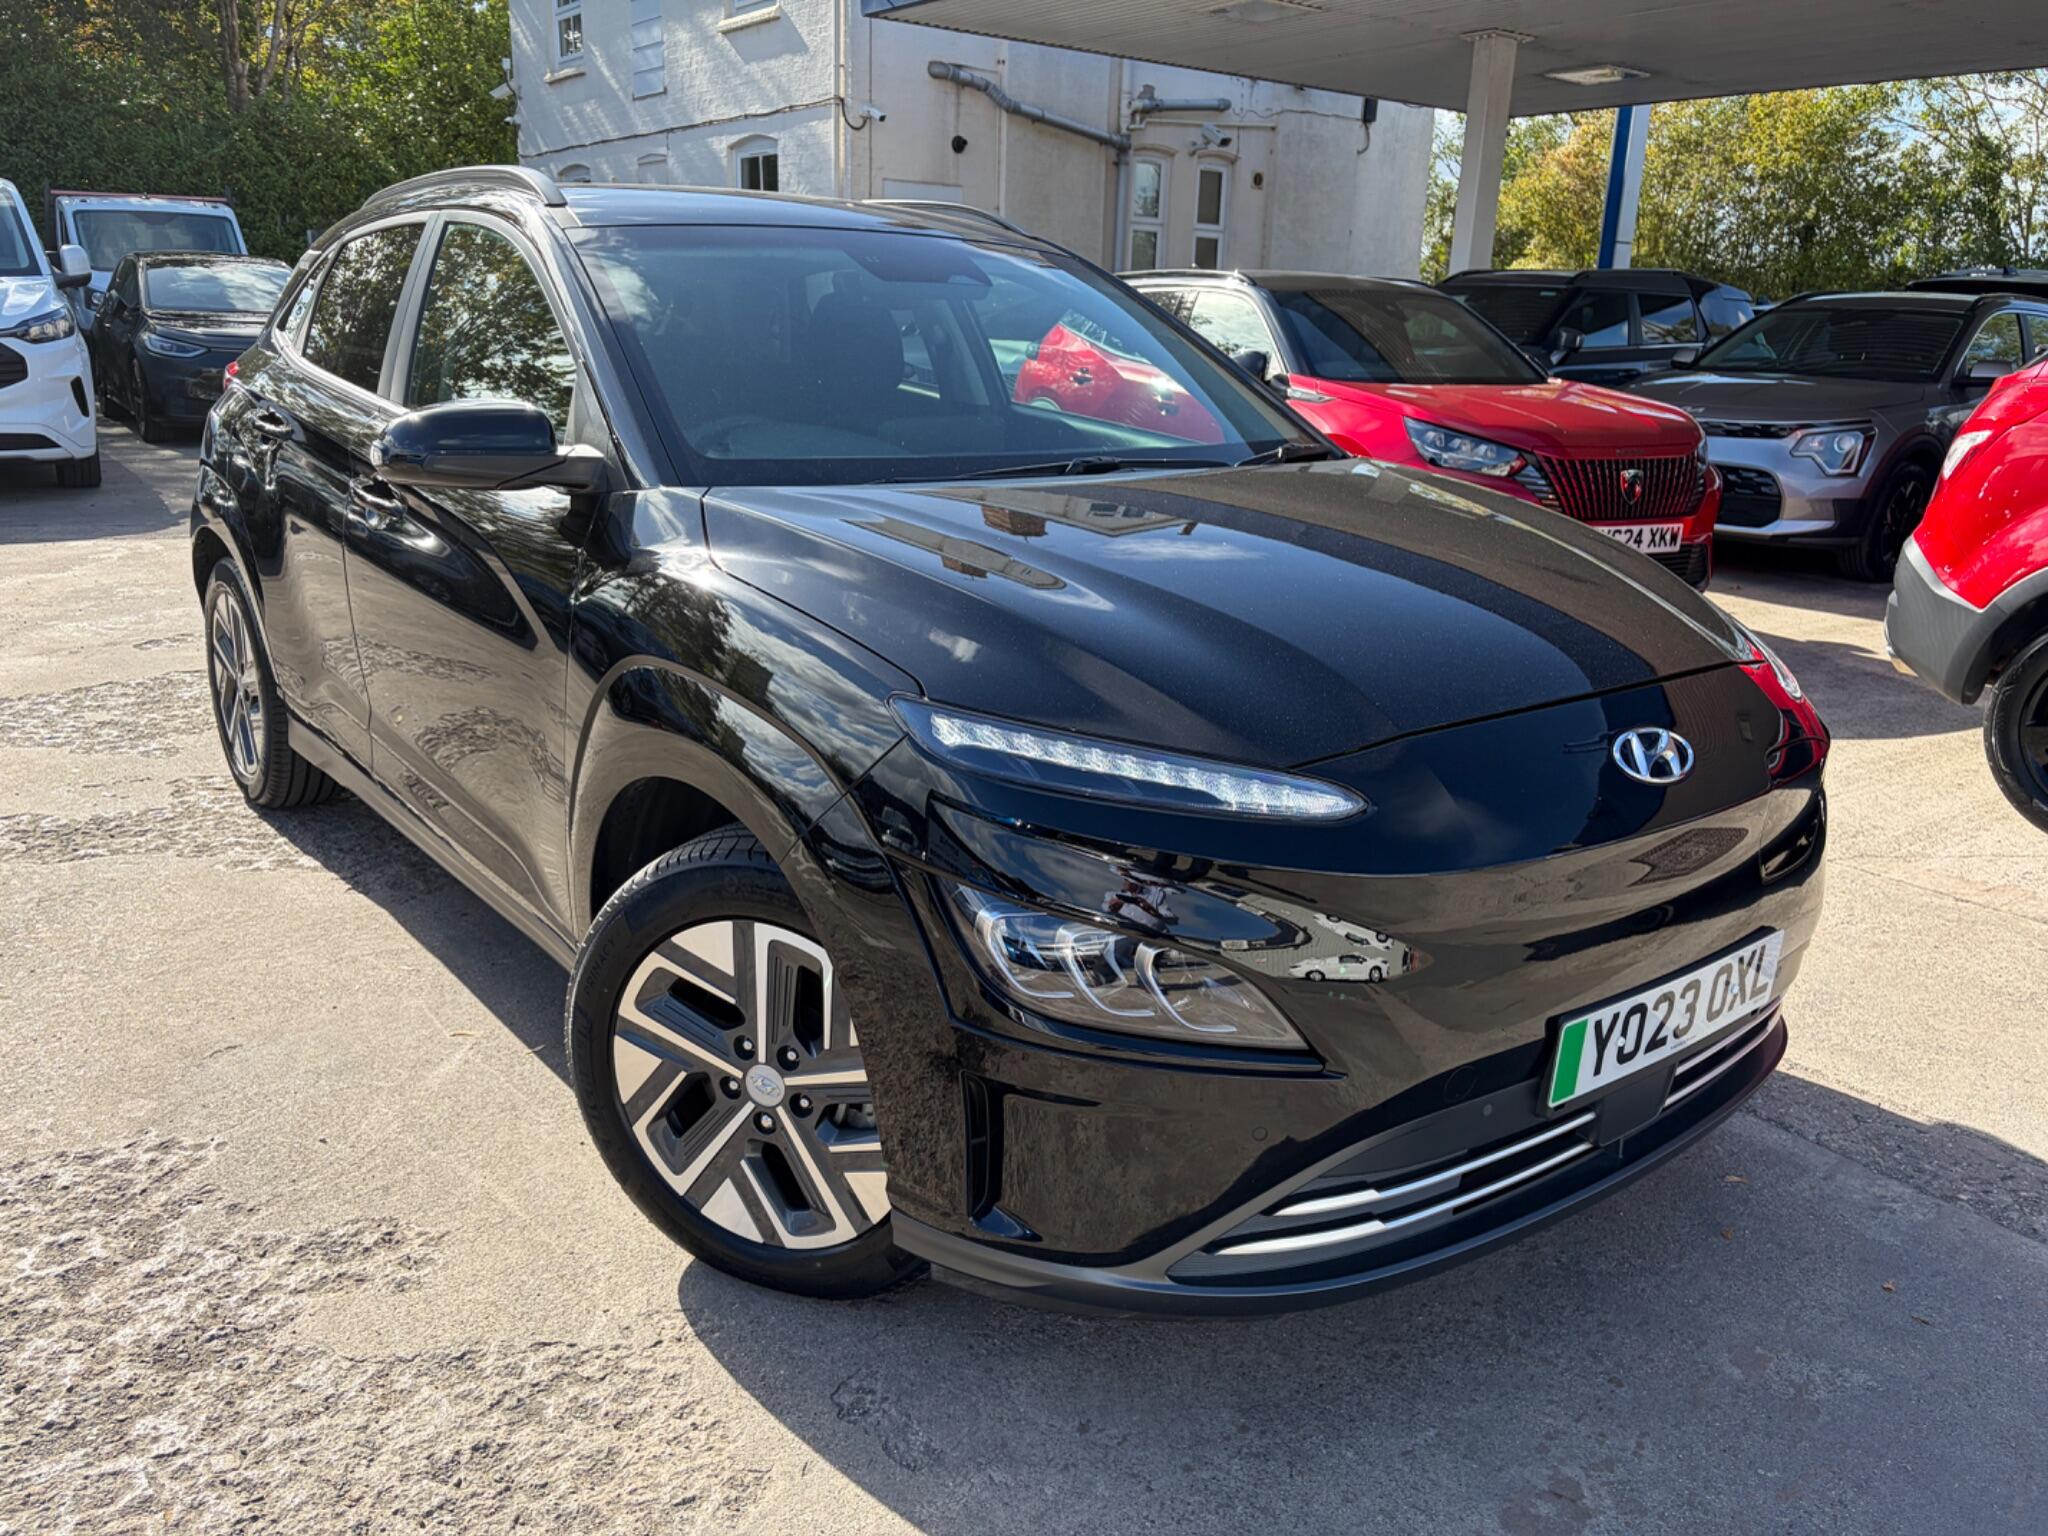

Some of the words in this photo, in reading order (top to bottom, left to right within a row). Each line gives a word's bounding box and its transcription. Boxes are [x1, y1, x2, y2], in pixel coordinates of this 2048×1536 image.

[1602, 528, 1643, 548] 24
[1647, 526, 1680, 548] XKW
[1592, 978, 1702, 1077] YO23
[1706, 944, 1769, 1023] OXL
